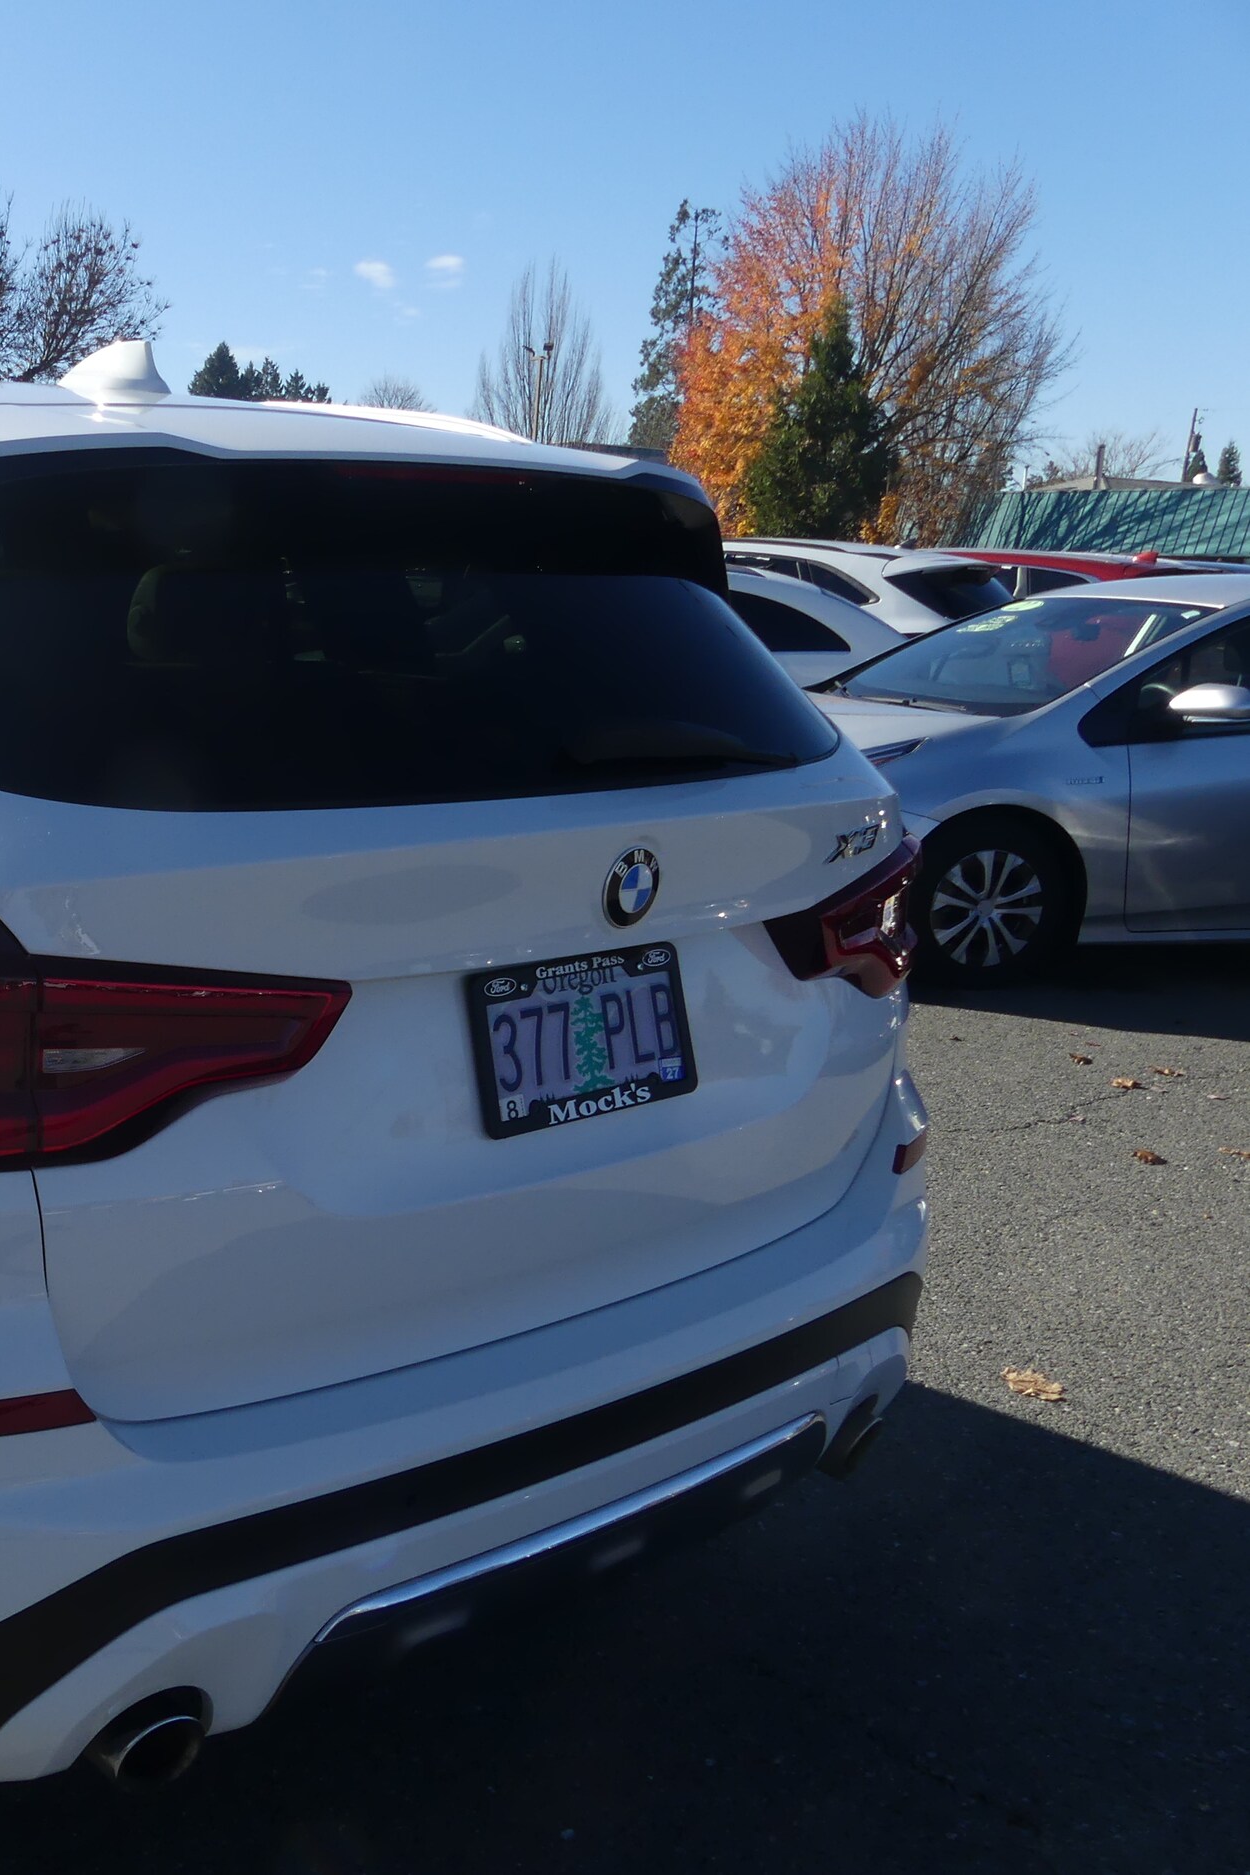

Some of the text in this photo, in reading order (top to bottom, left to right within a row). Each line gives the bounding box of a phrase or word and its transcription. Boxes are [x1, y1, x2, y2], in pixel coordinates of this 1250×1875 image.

[614, 849, 659, 878] BMW
[535, 955, 625, 980] Grants Pass
[646, 950, 668, 965] Ford
[489, 979, 513, 995] Ford
[543, 967, 617, 995] Oregon
[492, 984, 679, 1092] 377 PLB
[666, 1067, 679, 1080] 27
[507, 1100, 519, 1119] 8
[548, 1083, 651, 1125] Mock's
